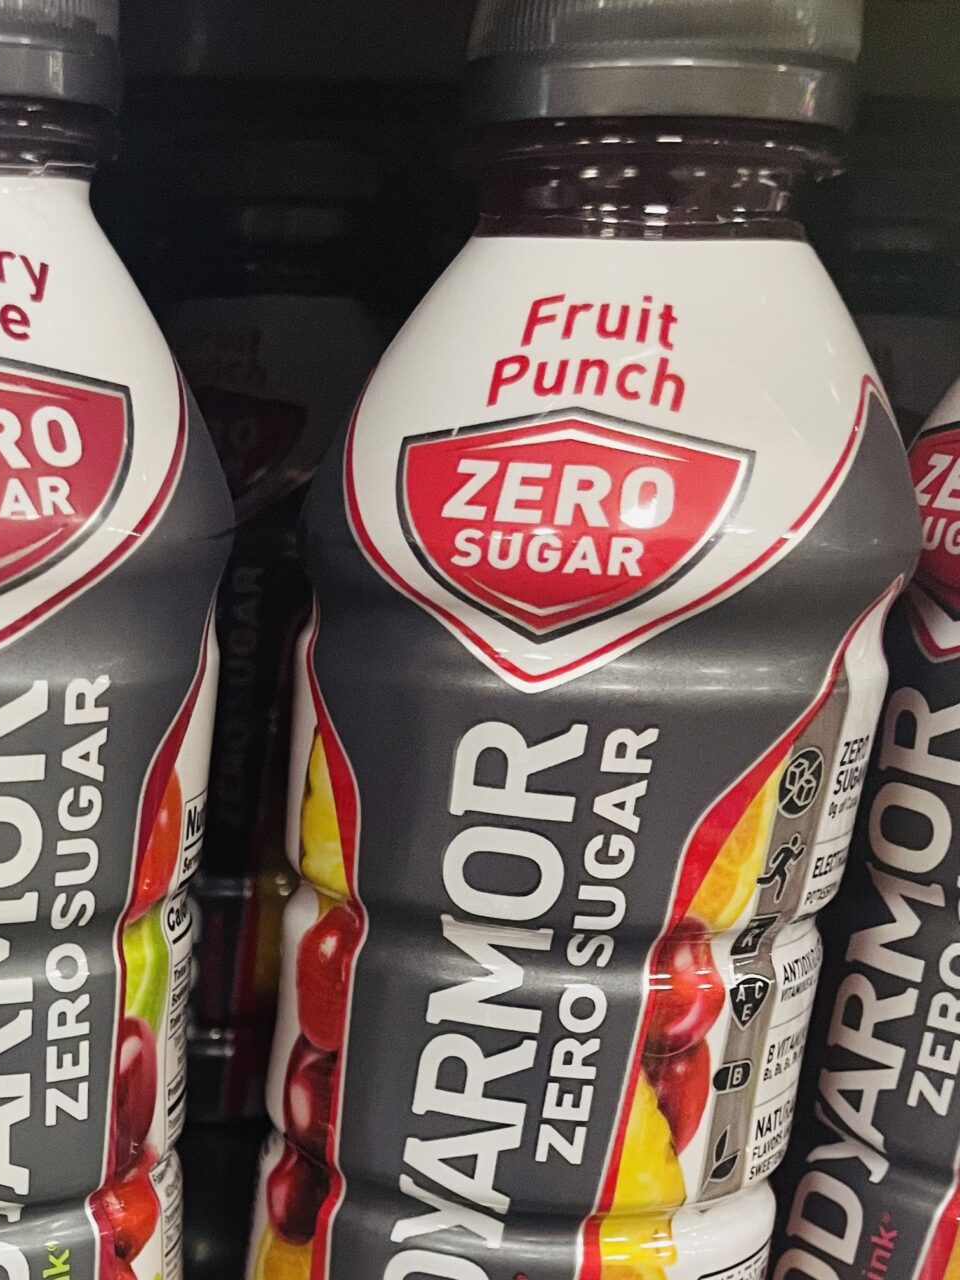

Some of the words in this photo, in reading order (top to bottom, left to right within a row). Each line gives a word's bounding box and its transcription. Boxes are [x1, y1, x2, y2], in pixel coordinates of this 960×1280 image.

[486, 355, 686, 413] Punch
[520, 294, 678, 350] Fruit
[440, 458, 676, 530] ZERO
[450, 529, 643, 577] SUGAR
[50, 674, 111, 930] SUGAR
[566, 727, 660, 968] SUGAR
[45, 942, 92, 1127] ZERO
[534, 983, 608, 1165] ZERO
